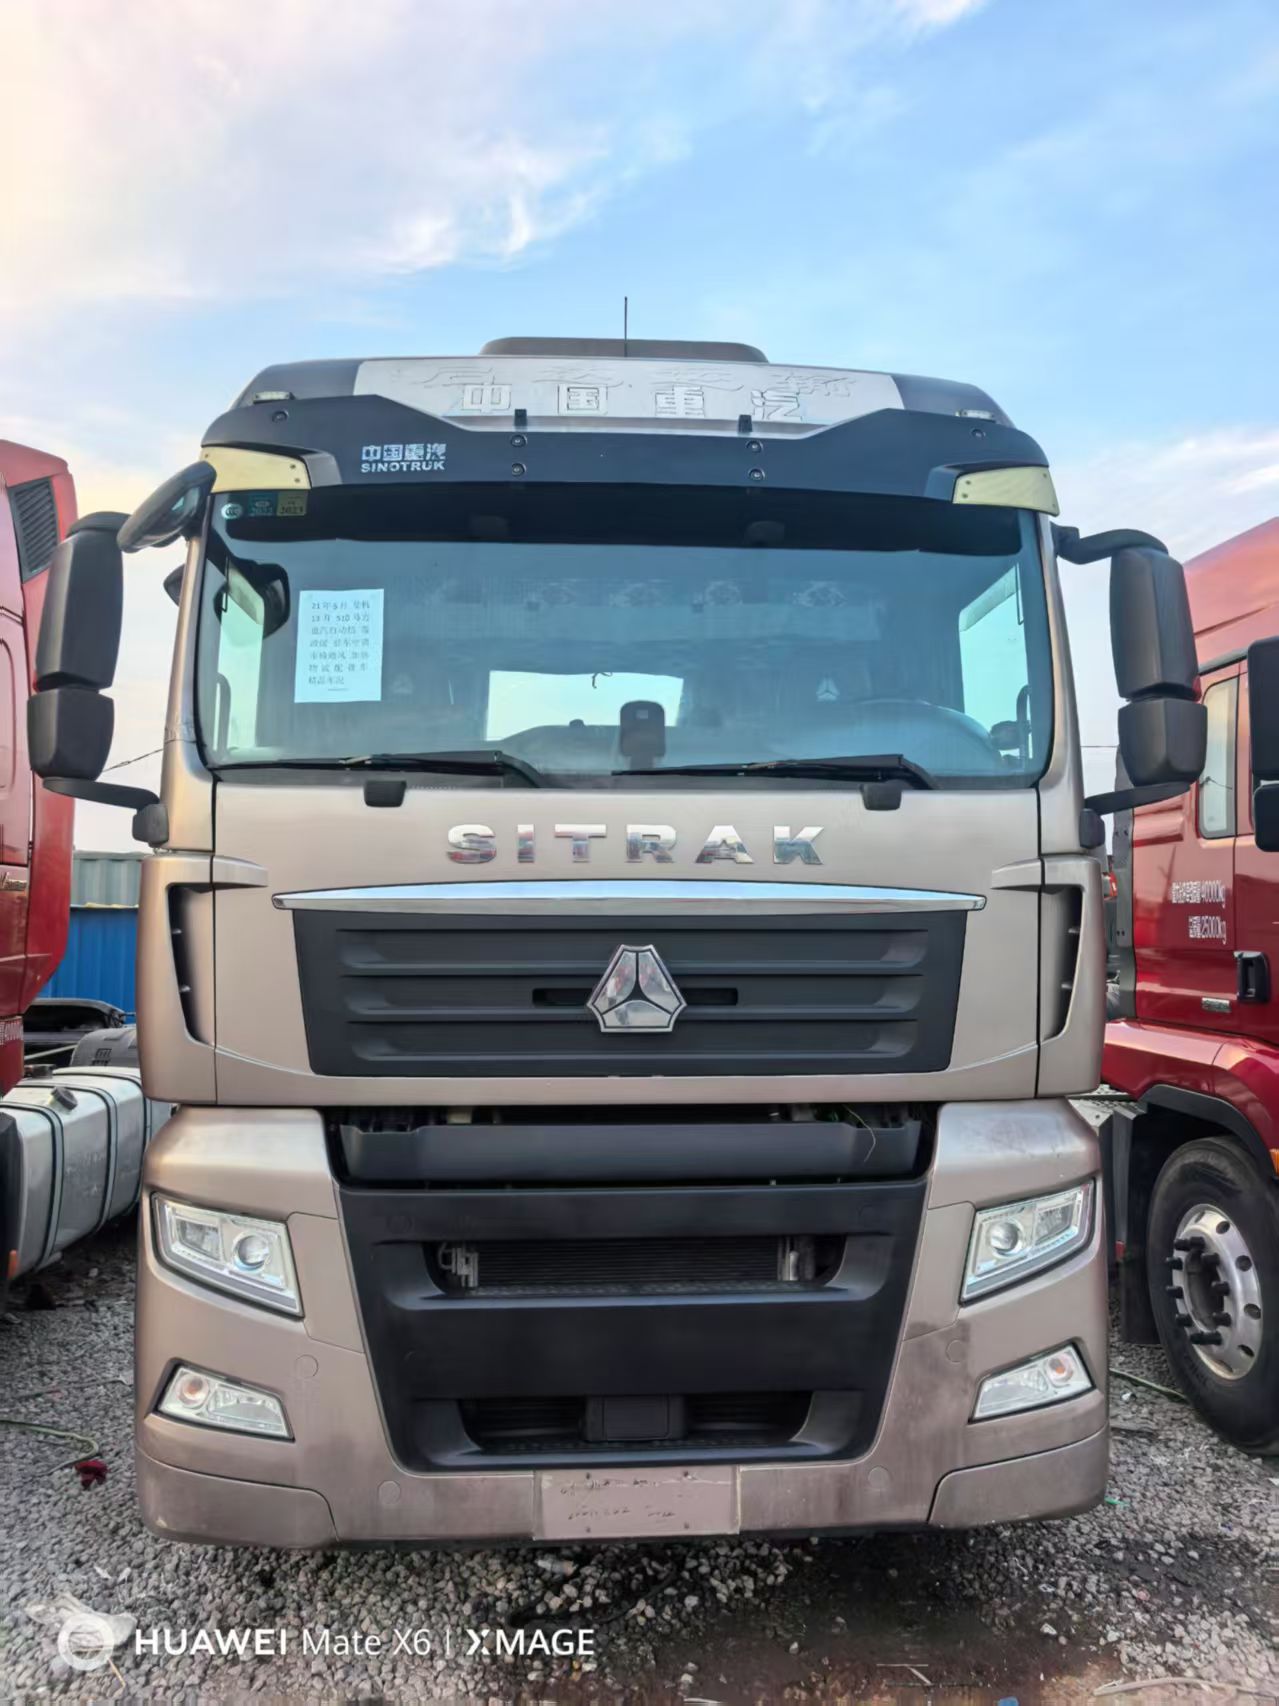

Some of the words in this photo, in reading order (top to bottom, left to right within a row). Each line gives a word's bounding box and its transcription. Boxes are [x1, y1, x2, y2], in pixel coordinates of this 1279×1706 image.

[462, 382, 801, 421] 中国重汽
[361, 443, 446, 461] 中国重汽
[360, 461, 445, 473] SINOTRUK
[446, 824, 824, 864] SITRAK
